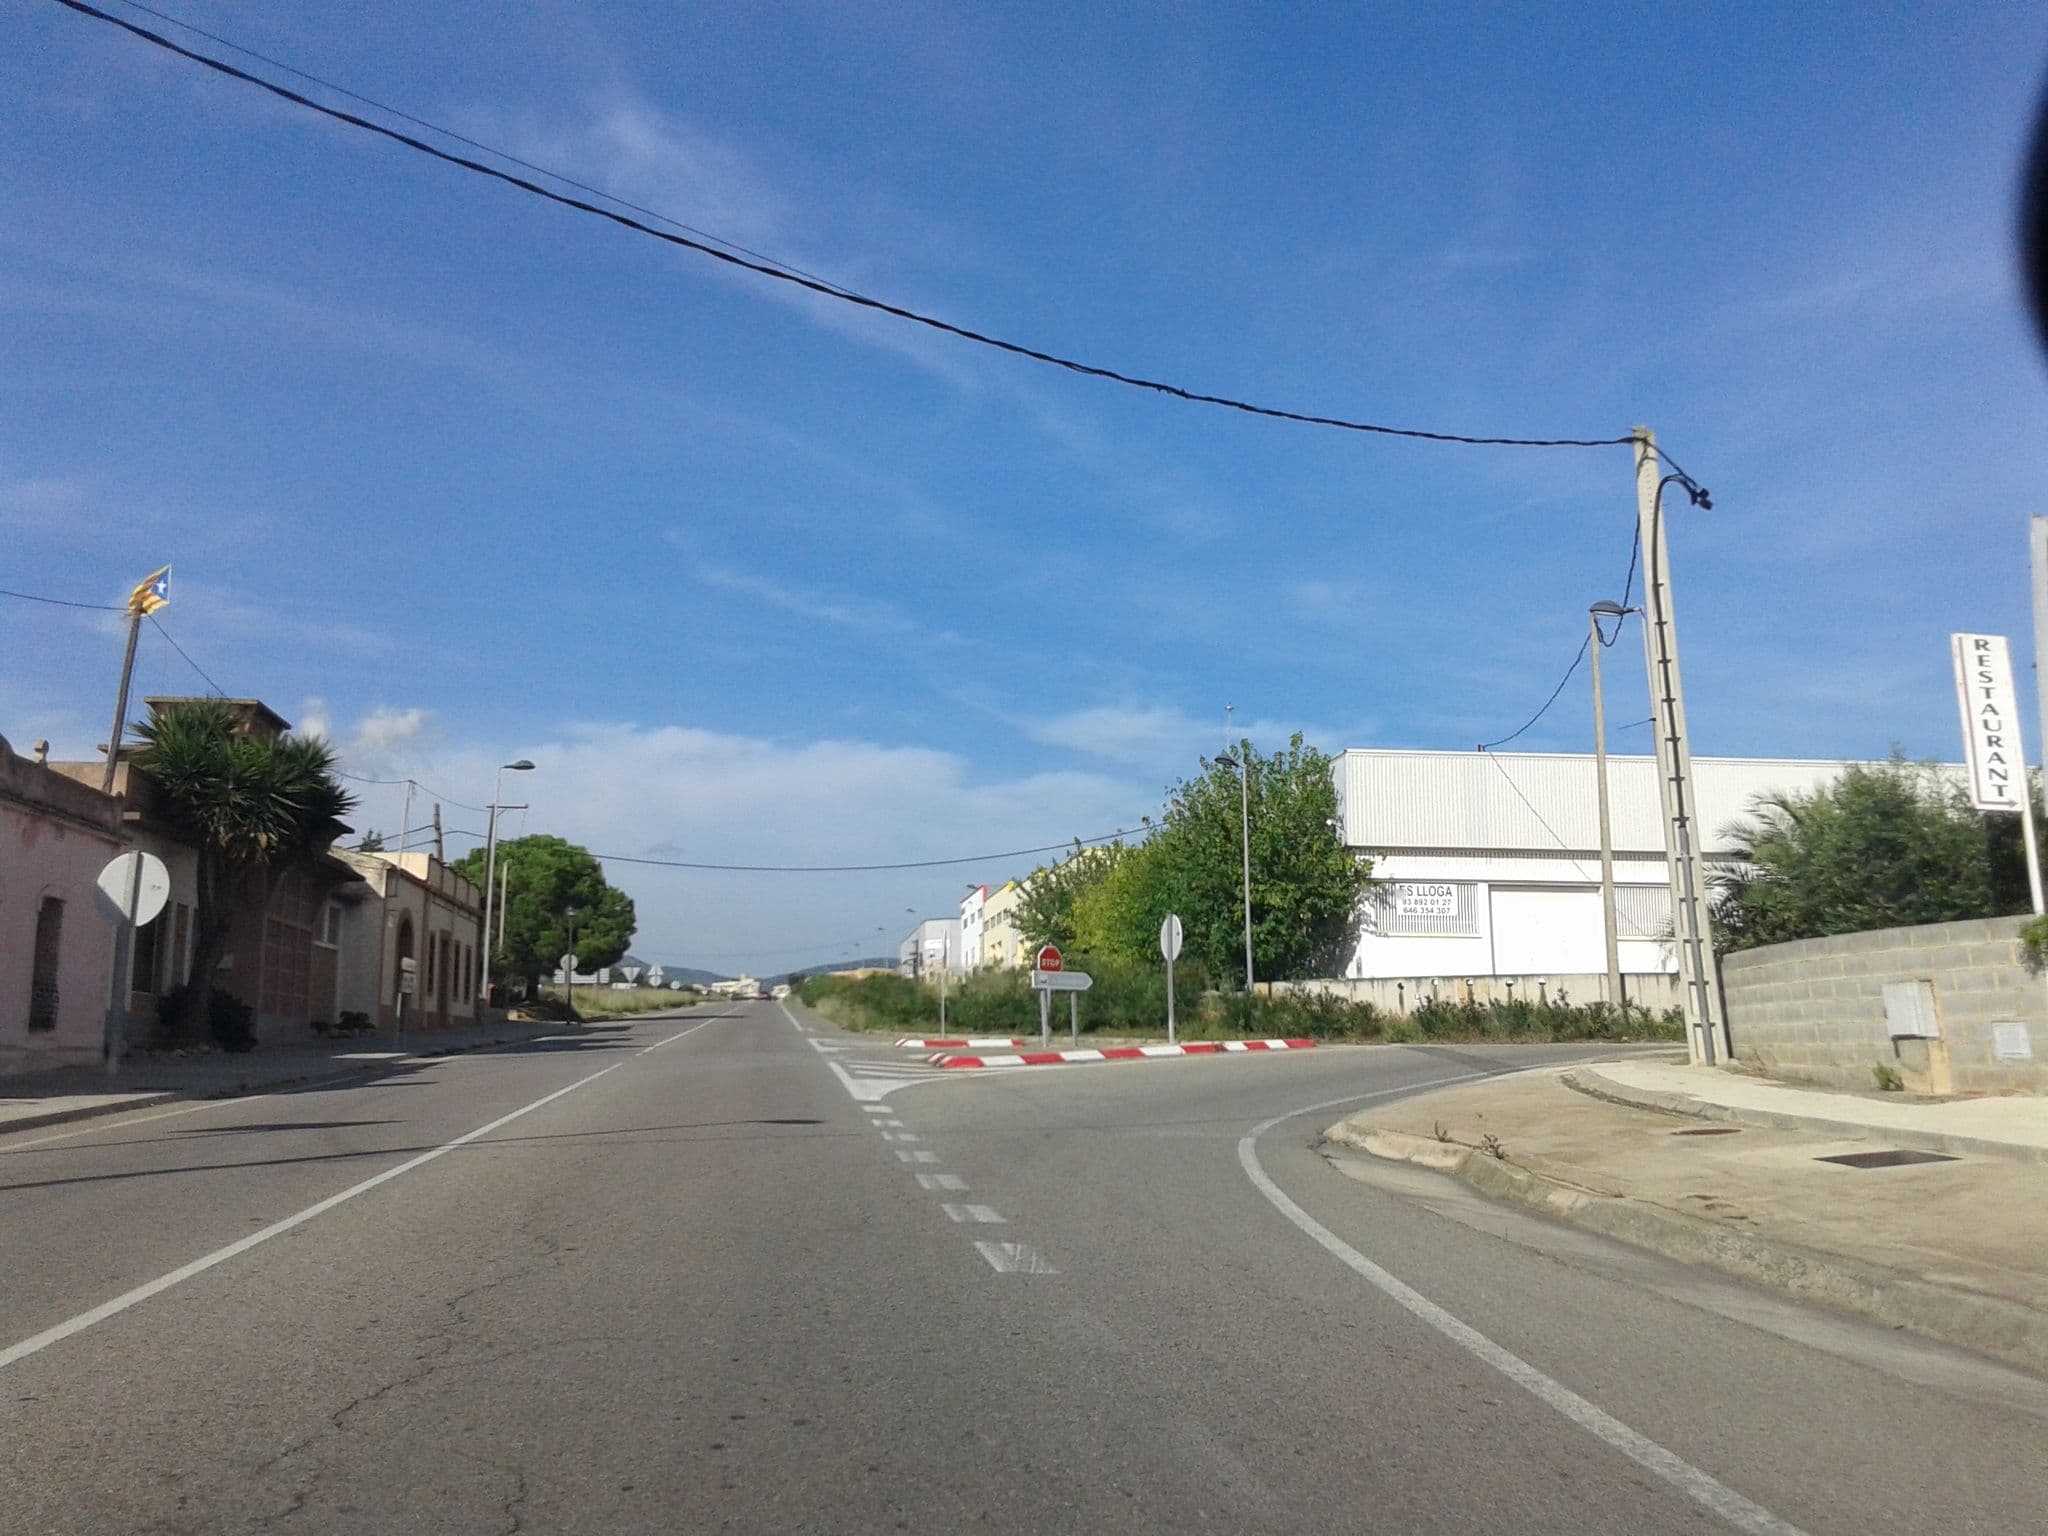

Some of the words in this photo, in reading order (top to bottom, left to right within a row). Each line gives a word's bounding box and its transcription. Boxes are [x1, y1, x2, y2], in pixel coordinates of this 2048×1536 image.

[1974, 638, 2008, 797] RESTAURANT
[1416, 885, 1453, 897] LLOGA
[1041, 958, 1061, 967] STOP
